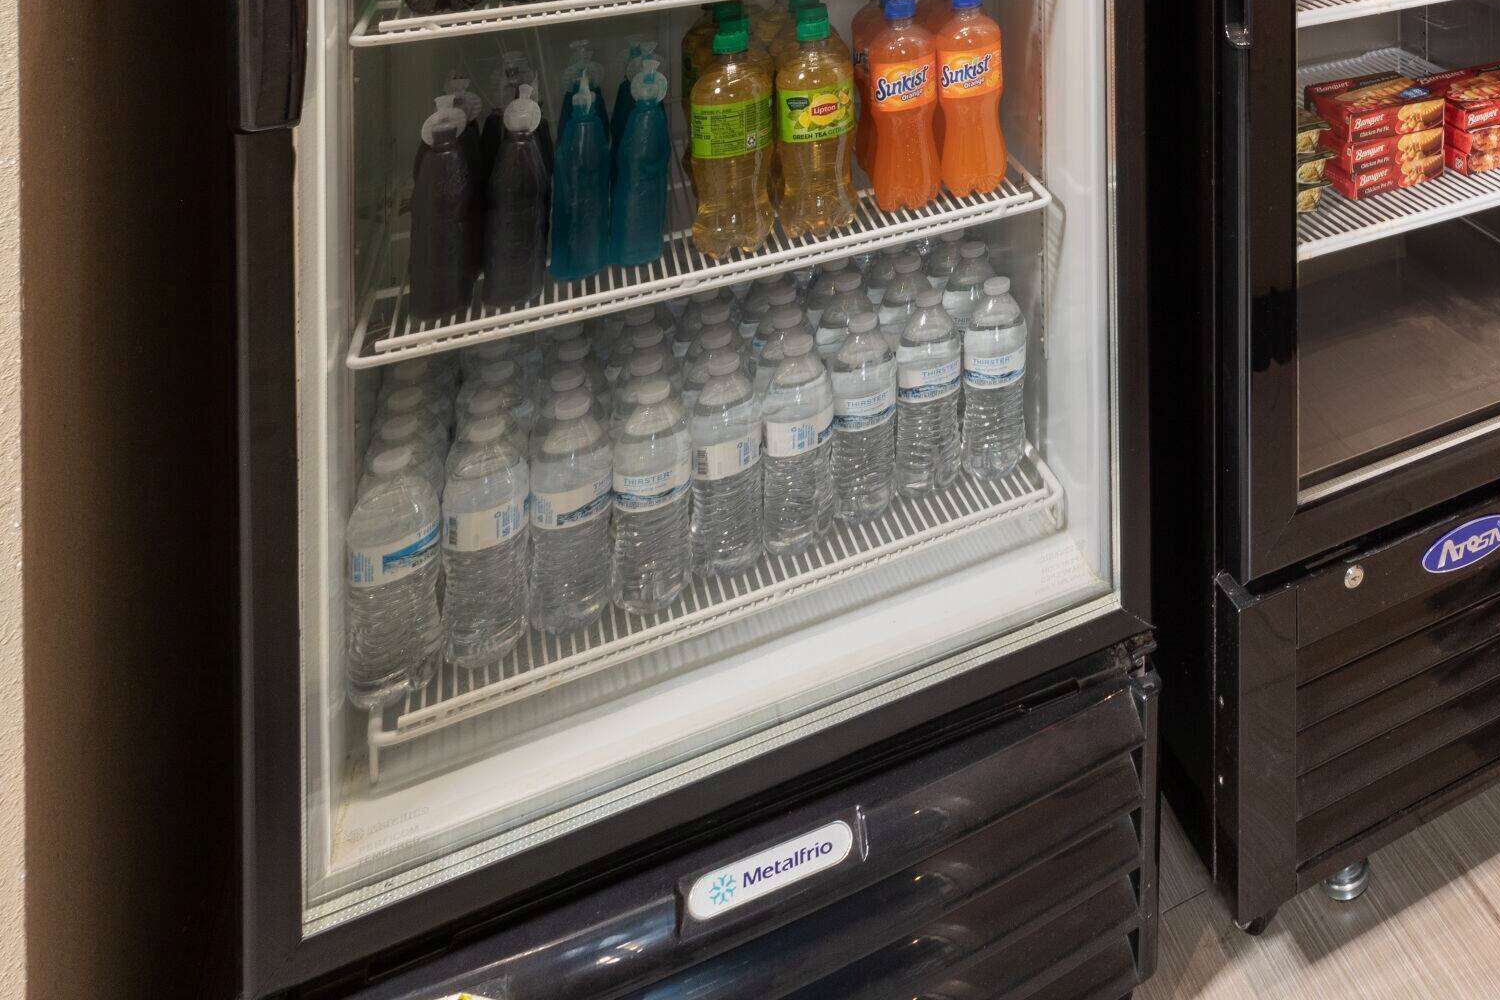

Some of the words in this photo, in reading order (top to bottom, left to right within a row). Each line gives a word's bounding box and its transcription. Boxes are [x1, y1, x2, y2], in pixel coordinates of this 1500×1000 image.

[942, 54, 992, 88] Sunkist
[876, 66, 929, 101] Sunkist
[964, 78, 985, 89] Orange
[901, 88, 923, 102] Orange
[813, 104, 837, 116] Lipton
[1467, 108, 1498, 125] Banquet
[1354, 113, 1385, 130] Banquet
[815, 131, 827, 139] TEA
[1355, 144, 1385, 160] Banquet
[1359, 168, 1389, 186] Banquet
[973, 355, 1012, 366] THIRSTER
[847, 391, 888, 408] THIRSTER
[624, 470, 671, 486] THIRSTER
[1437, 526, 1500, 568] ATOSA
[742, 840, 833, 888] Metalfrio
